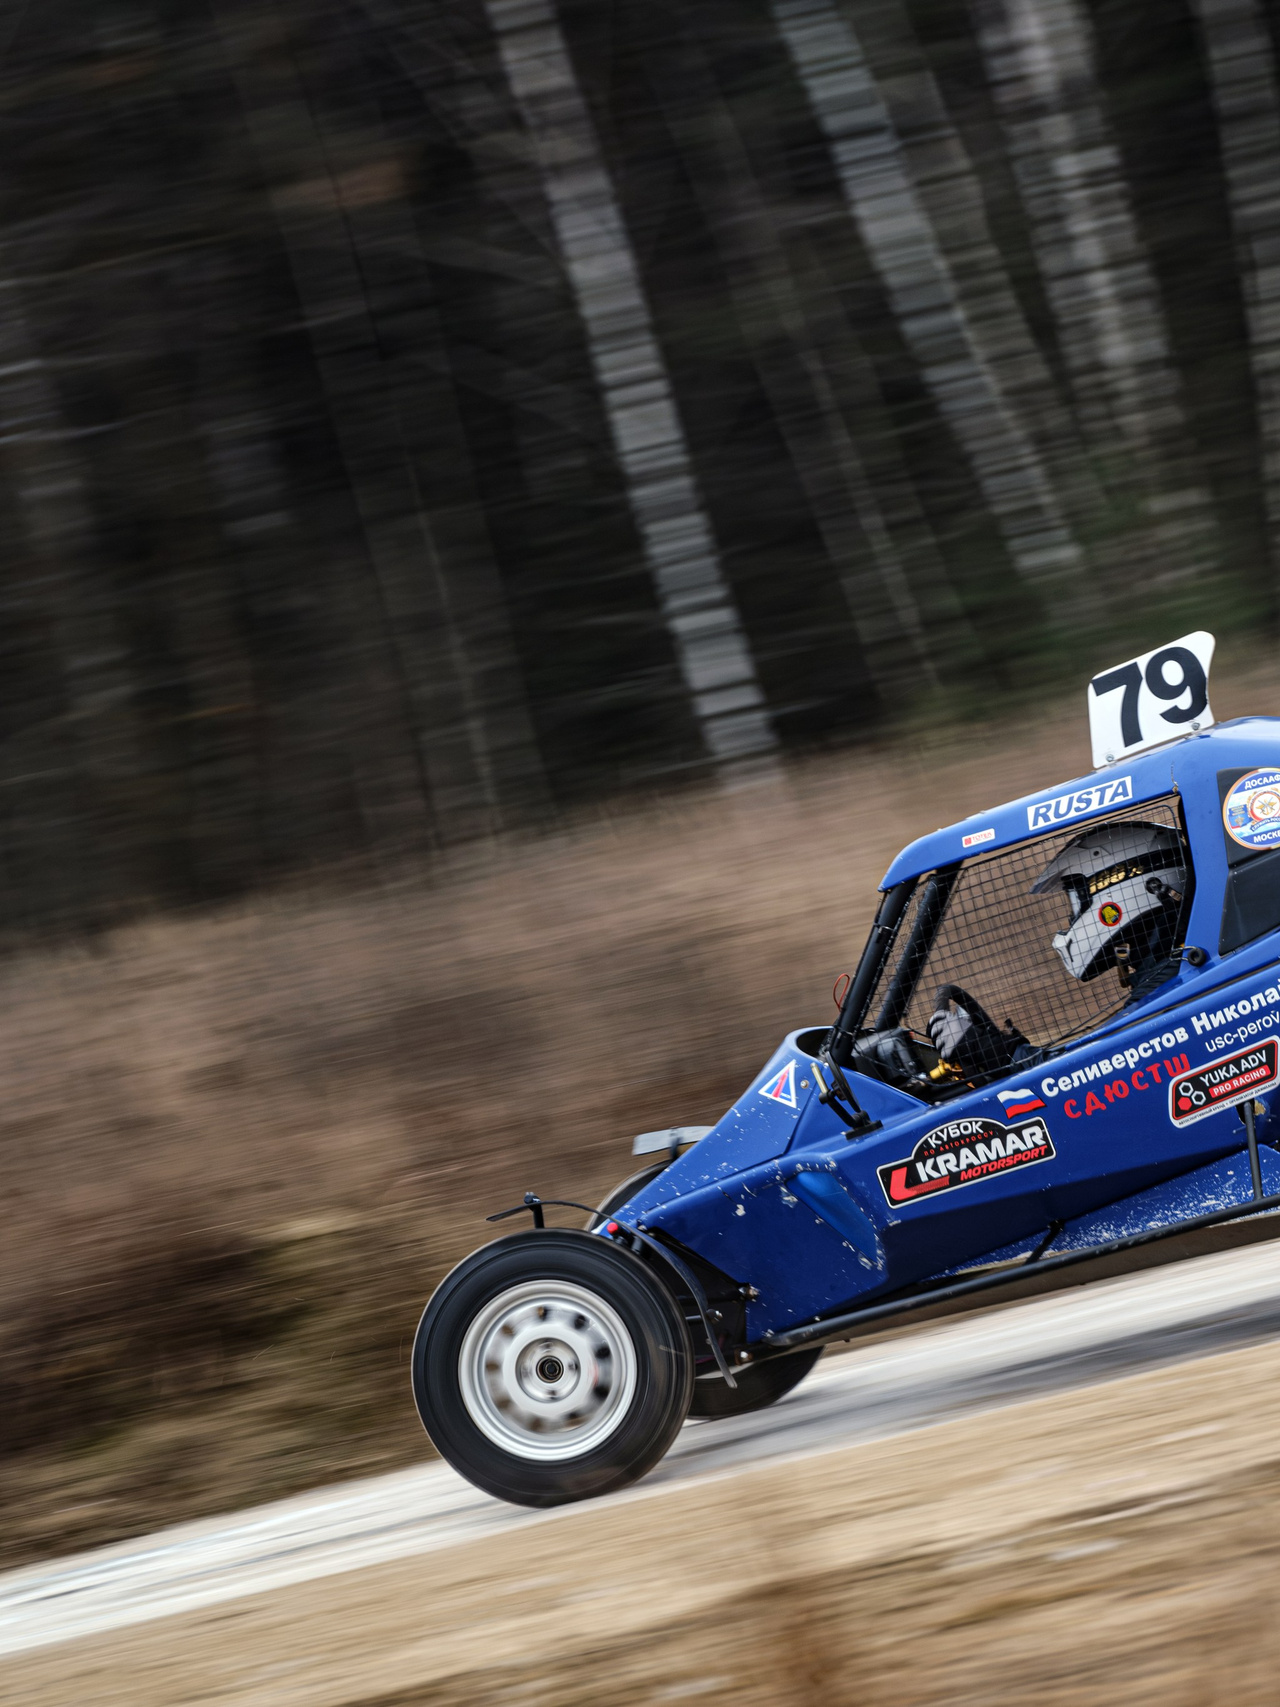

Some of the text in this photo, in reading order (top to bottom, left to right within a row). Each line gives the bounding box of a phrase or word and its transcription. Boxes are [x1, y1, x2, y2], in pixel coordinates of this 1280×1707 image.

[1091, 646, 1208, 748] 79
[1032, 779, 1130, 828] RUSTA
[1041, 1026, 1190, 1097] Селиверстов
[1199, 1049, 1268, 1087] YUKA ADV
[1213, 1068, 1267, 1096] PRO RACING
[1064, 1053, 1191, 1119] СДЮСТШ
[915, 1125, 1047, 1183] KRAMAR
[923, 1130, 994, 1157] ПО АВТОКРОССУ
[927, 1120, 984, 1149] КУБОК
[960, 1145, 1048, 1182] MOTORSPORT
